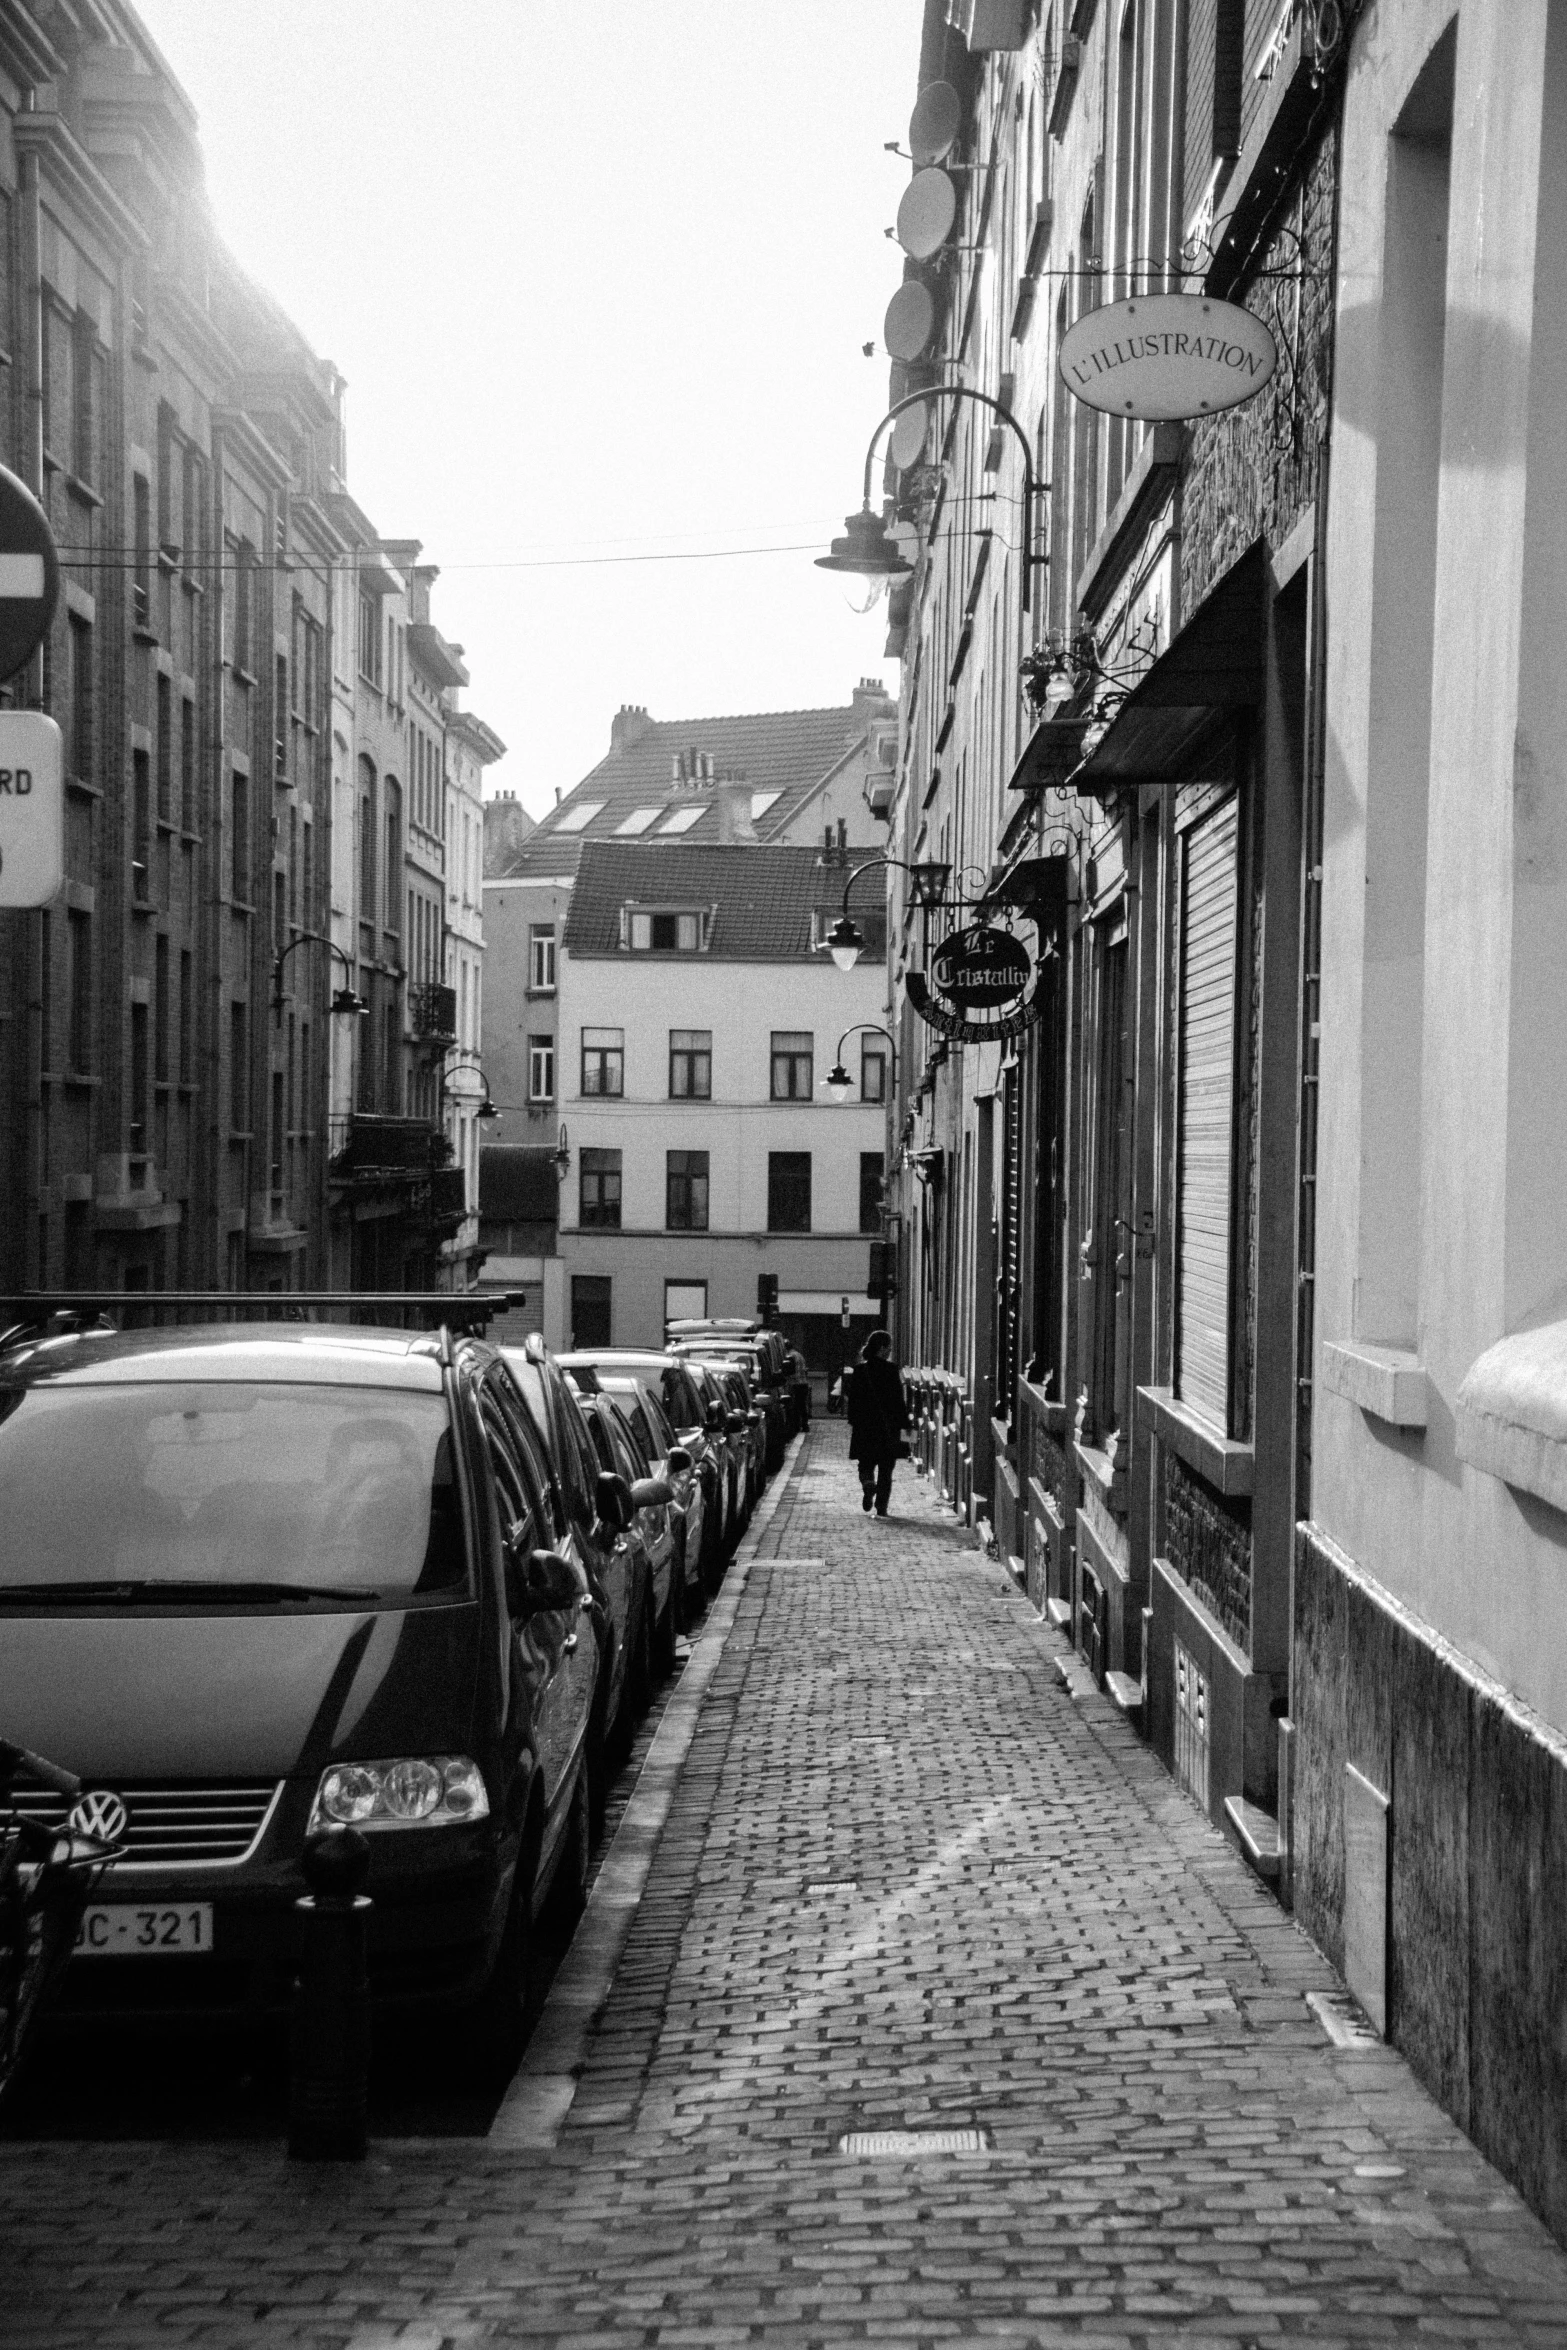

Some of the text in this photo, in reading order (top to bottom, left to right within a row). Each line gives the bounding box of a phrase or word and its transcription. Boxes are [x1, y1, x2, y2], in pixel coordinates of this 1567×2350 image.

[1071, 333, 1264, 385] L'ILLUSTRATION
[963, 929, 995, 956] Le
[932, 956, 1029, 988] Cristallin
